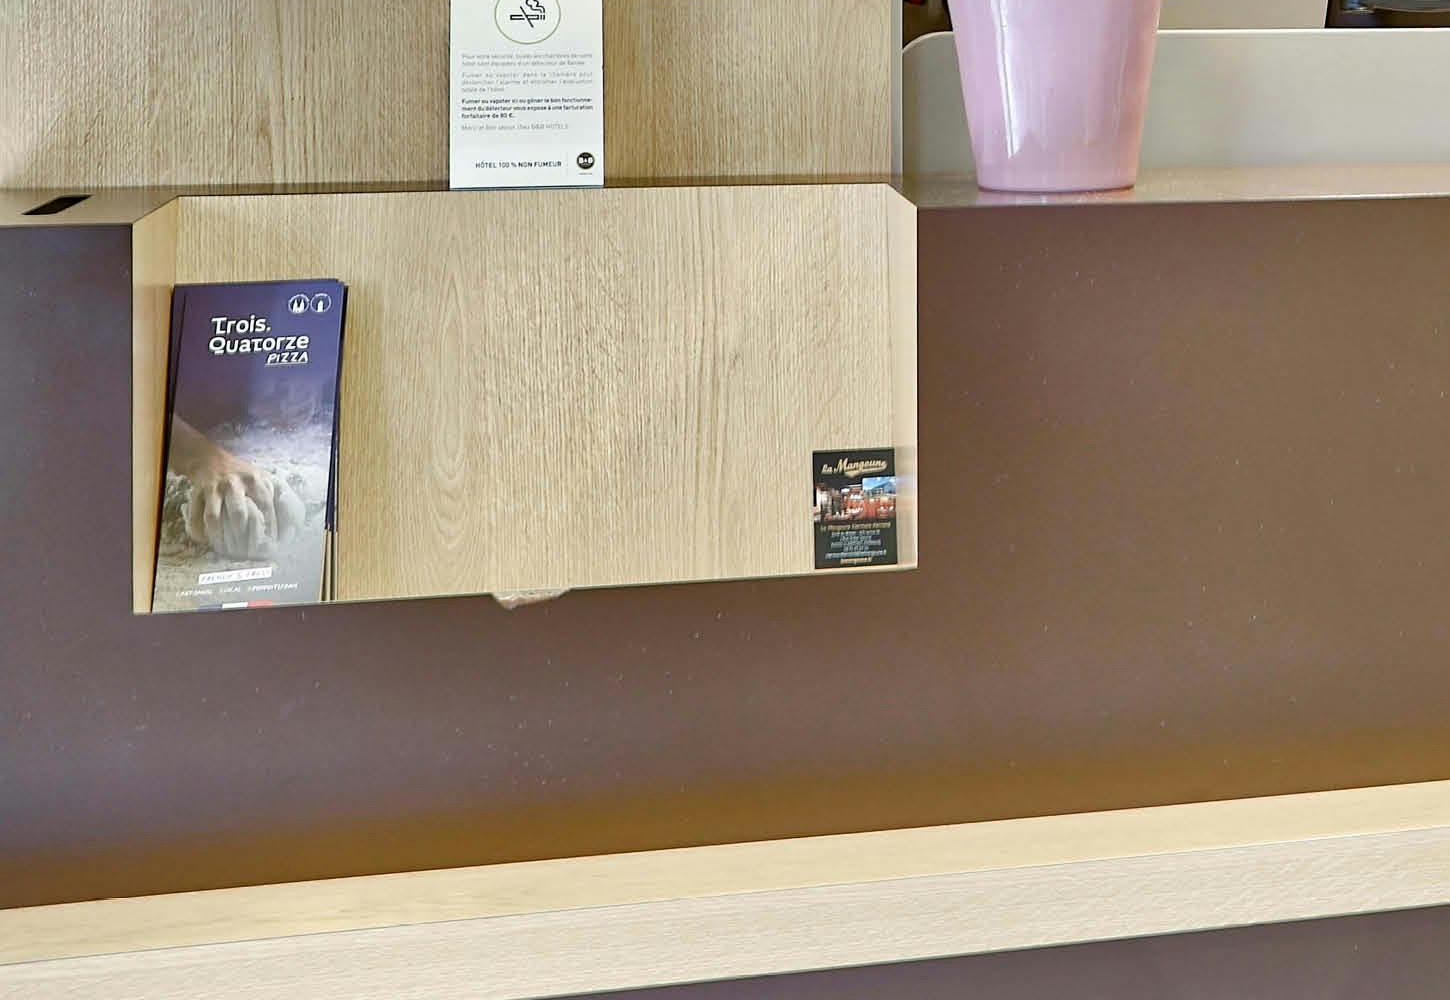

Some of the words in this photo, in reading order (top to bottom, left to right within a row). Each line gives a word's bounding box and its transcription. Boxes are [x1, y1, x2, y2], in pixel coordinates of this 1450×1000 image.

[212, 315, 271, 334] Trois.
[209, 335, 309, 355] Quatorze
[268, 353, 308, 364] PIZZA
